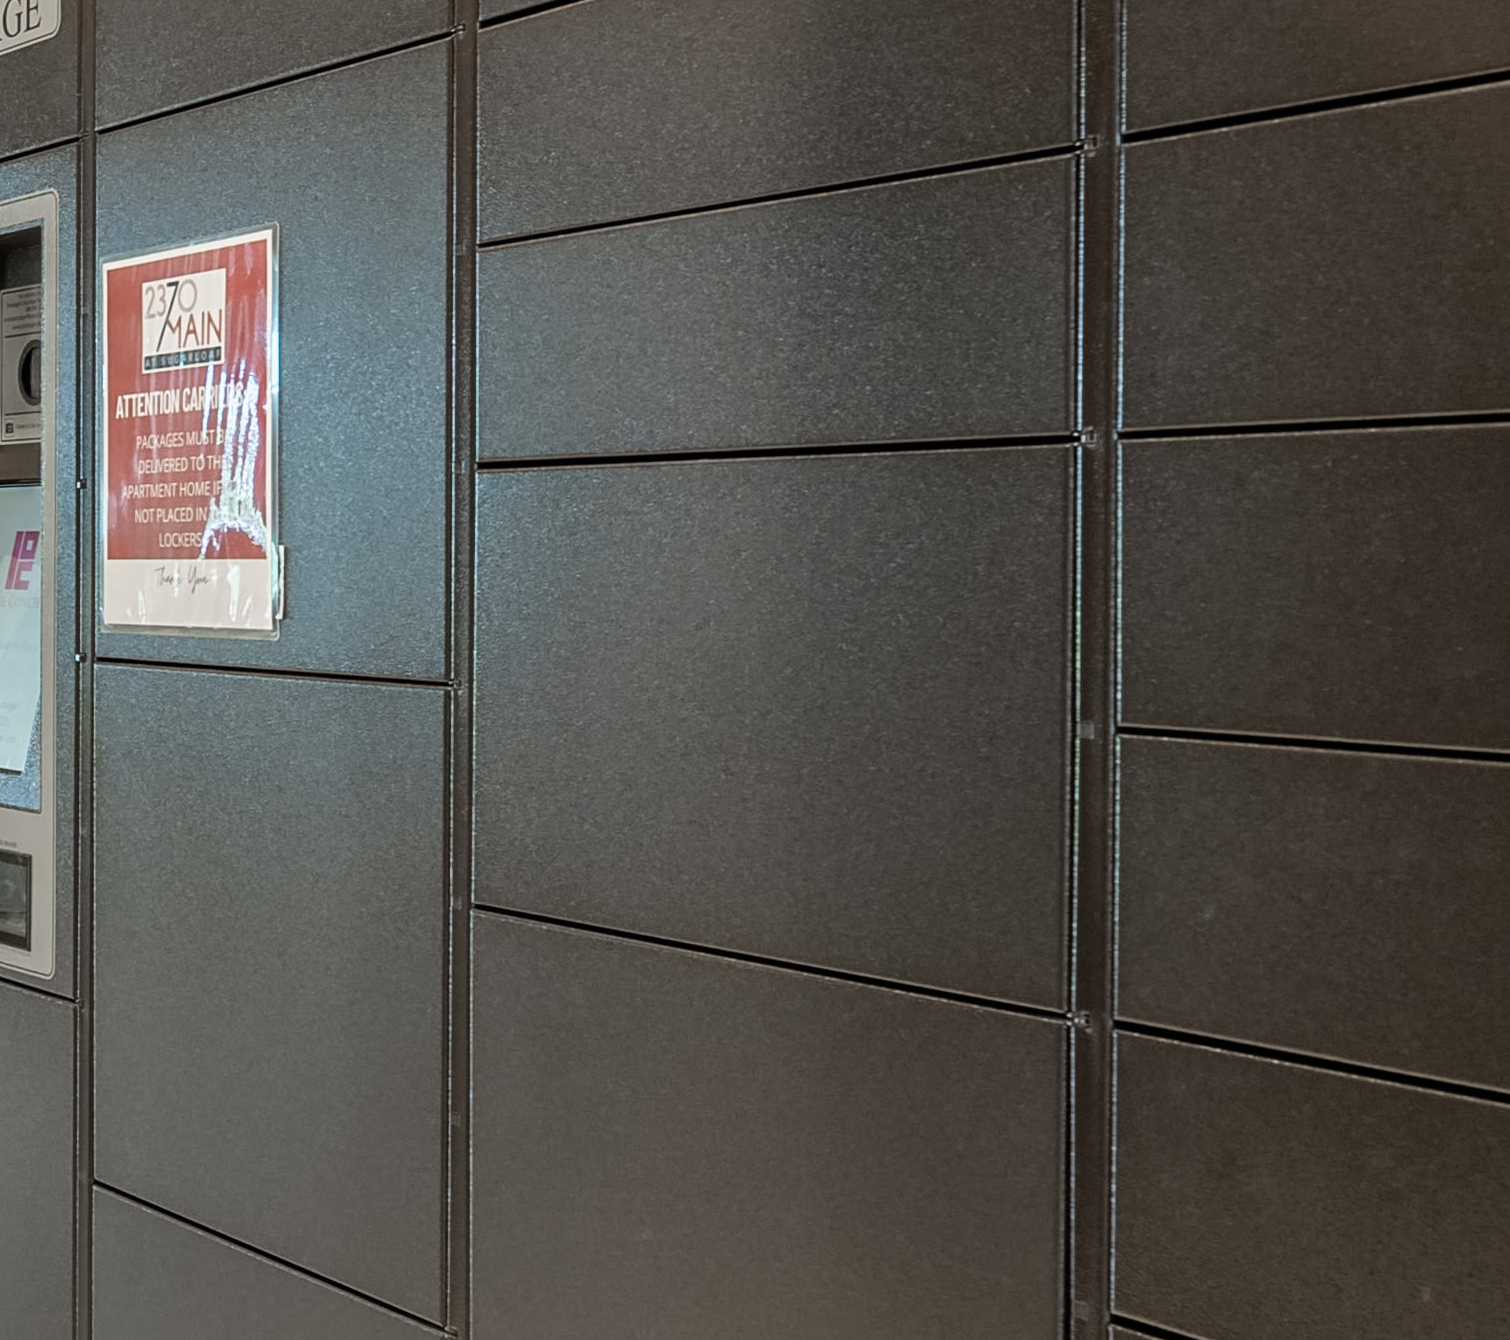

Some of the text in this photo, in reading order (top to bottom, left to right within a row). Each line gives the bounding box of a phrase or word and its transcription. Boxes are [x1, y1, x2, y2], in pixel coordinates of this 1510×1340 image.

[144, 279, 198, 352] 2370
[165, 308, 223, 349] MAIN
[145, 355, 158, 368] AT
[115, 381, 244, 419] ATTENTION CARRIS
[136, 431, 185, 450] PACKAGES
[186, 429, 216, 446] MUST
[138, 457, 189, 474] DELIVERED
[190, 455, 206, 471] TO
[122, 482, 178, 499] APARTMENT
[179, 481, 211, 497] HOME
[134, 508, 156, 523] NOT
[156, 507, 194, 523] PLACED
[195, 506, 208, 522] IN
[187, 565, 210, 594] You
